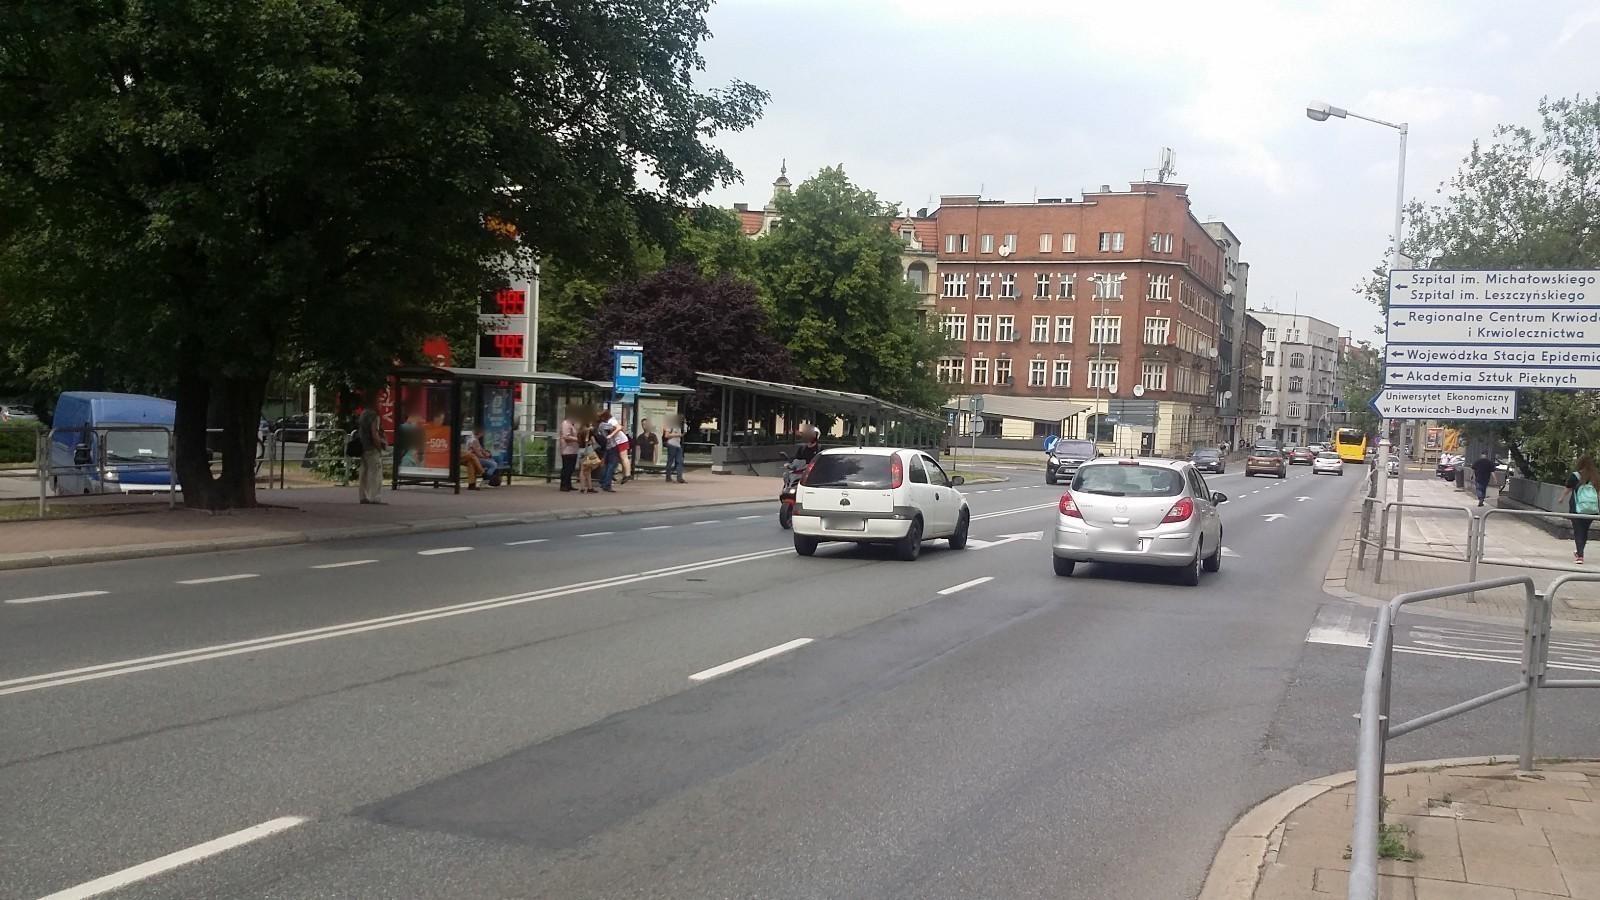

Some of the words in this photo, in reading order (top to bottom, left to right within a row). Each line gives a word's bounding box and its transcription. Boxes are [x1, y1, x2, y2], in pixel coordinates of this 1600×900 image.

[1412, 274, 1454, 286] Szpital
[1461, 274, 1479, 284] im.
[1486, 274, 1595, 286] Michałowskiego
[1411, 290, 1454, 302] Szpital
[1460, 290, 1478, 300] im.
[1485, 290, 1584, 302] Leszczyńskiego
[1409, 312, 1482, 324] Regionalne
[1490, 312, 1544, 322] Centrum
[1552, 312, 1600, 322] Krwiod
[1478, 328, 1583, 338] Krwiolecznictwa
[1407, 350, 1488, 363] Wojewódzka
[1494, 351, 1534, 363] Stacja
[1407, 371, 1471, 381] Akademia
[1478, 372, 1512, 382] Sztuk
[1519, 373, 1577, 386] Pięknych
[1386, 393, 1440, 402] Uniwersytet
[1447, 393, 1509, 403] Ekonomiczny
[1395, 405, 1497, 416] Katowicach-Budynek
[1501, 406, 1509, 415] N
